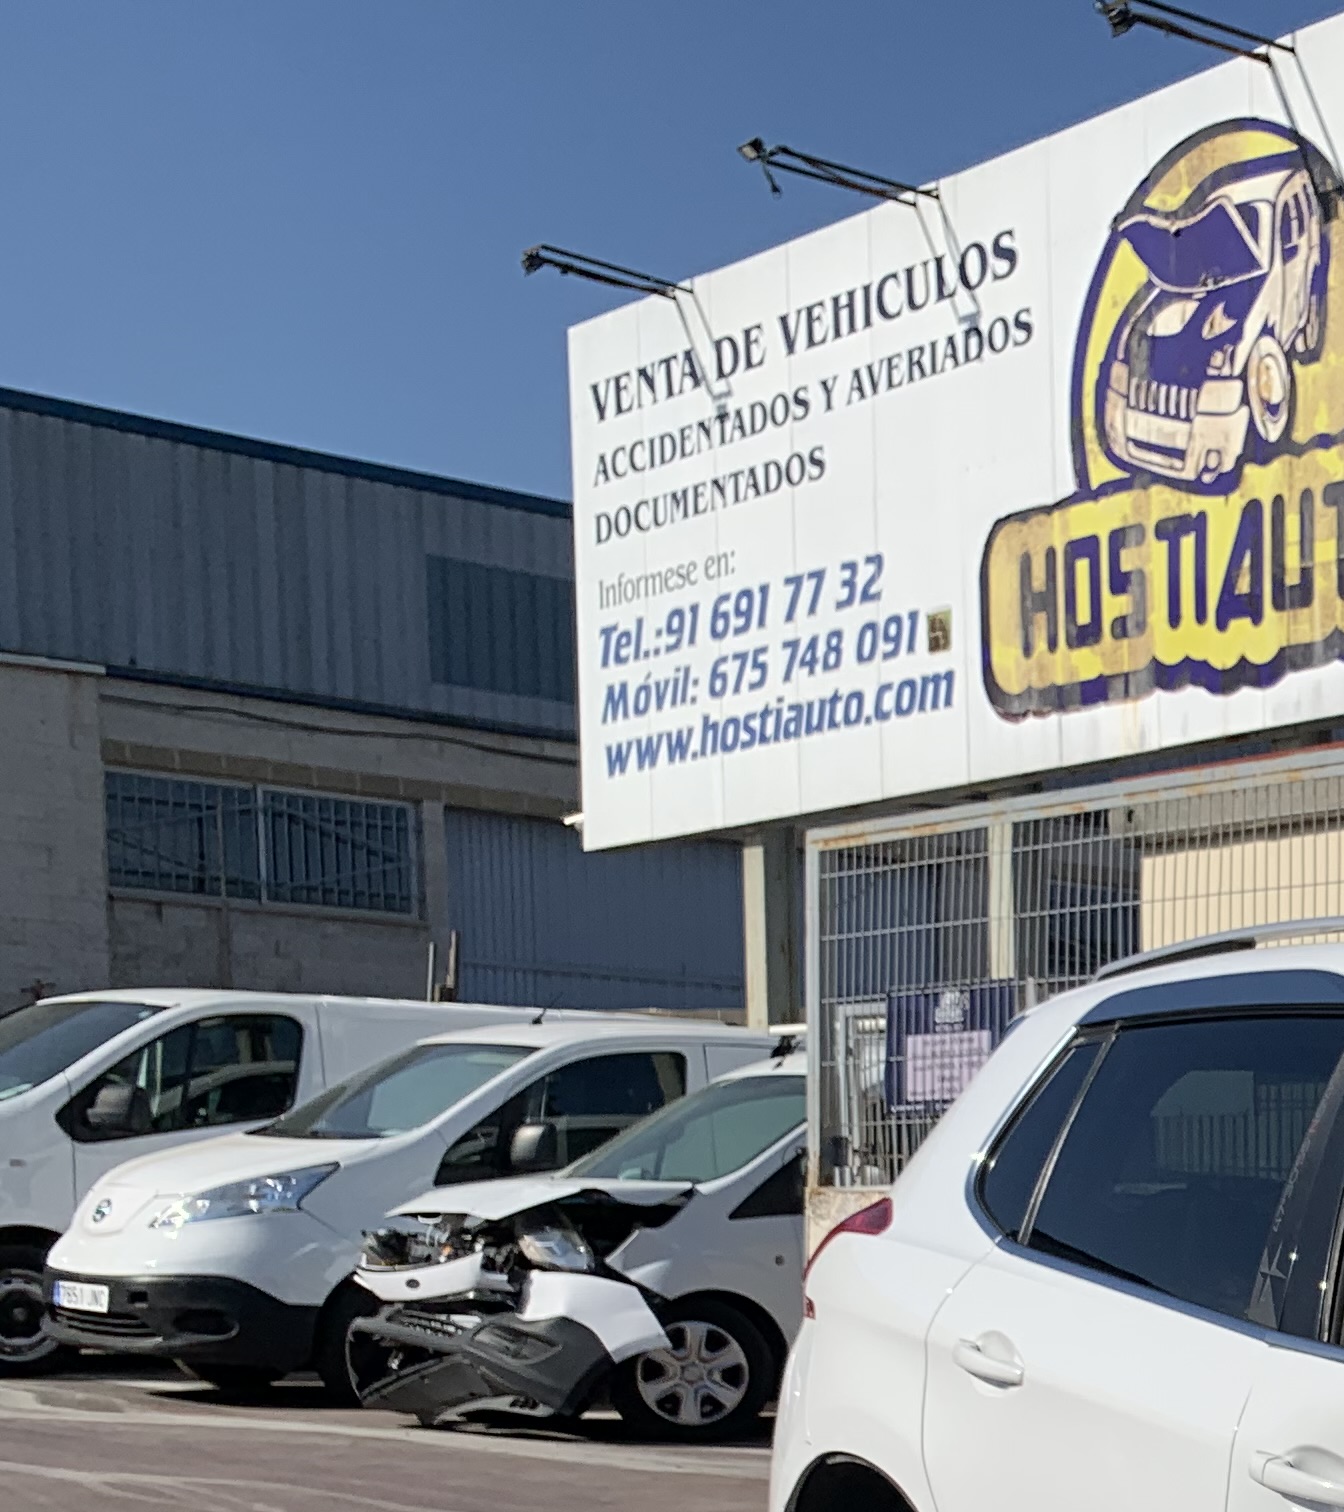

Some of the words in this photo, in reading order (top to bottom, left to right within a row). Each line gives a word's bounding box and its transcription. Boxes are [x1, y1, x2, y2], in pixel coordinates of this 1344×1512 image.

[590, 348, 706, 424] VENTA
[713, 323, 767, 380] DE
[778, 227, 1018, 357] VEHICULOS
[593, 386, 811, 488] ACCIDENTADOS
[820, 374, 840, 414] Y
[846, 306, 1035, 407] AVERIADOS
[594, 446, 827, 546] DOCUMENTADOS
[598, 560, 698, 610] Informese
[704, 549, 736, 581] en:
[710, 582, 770, 641] 691
[783, 568, 827, 624] 77
[835, 553, 884, 611] 32
[601, 666, 699, 725] Móvil:
[708, 645, 769, 699] 675
[782, 628, 844, 683] 748
[856, 609, 919, 664] 091
[605, 669, 954, 778] www.hostiauto.com
